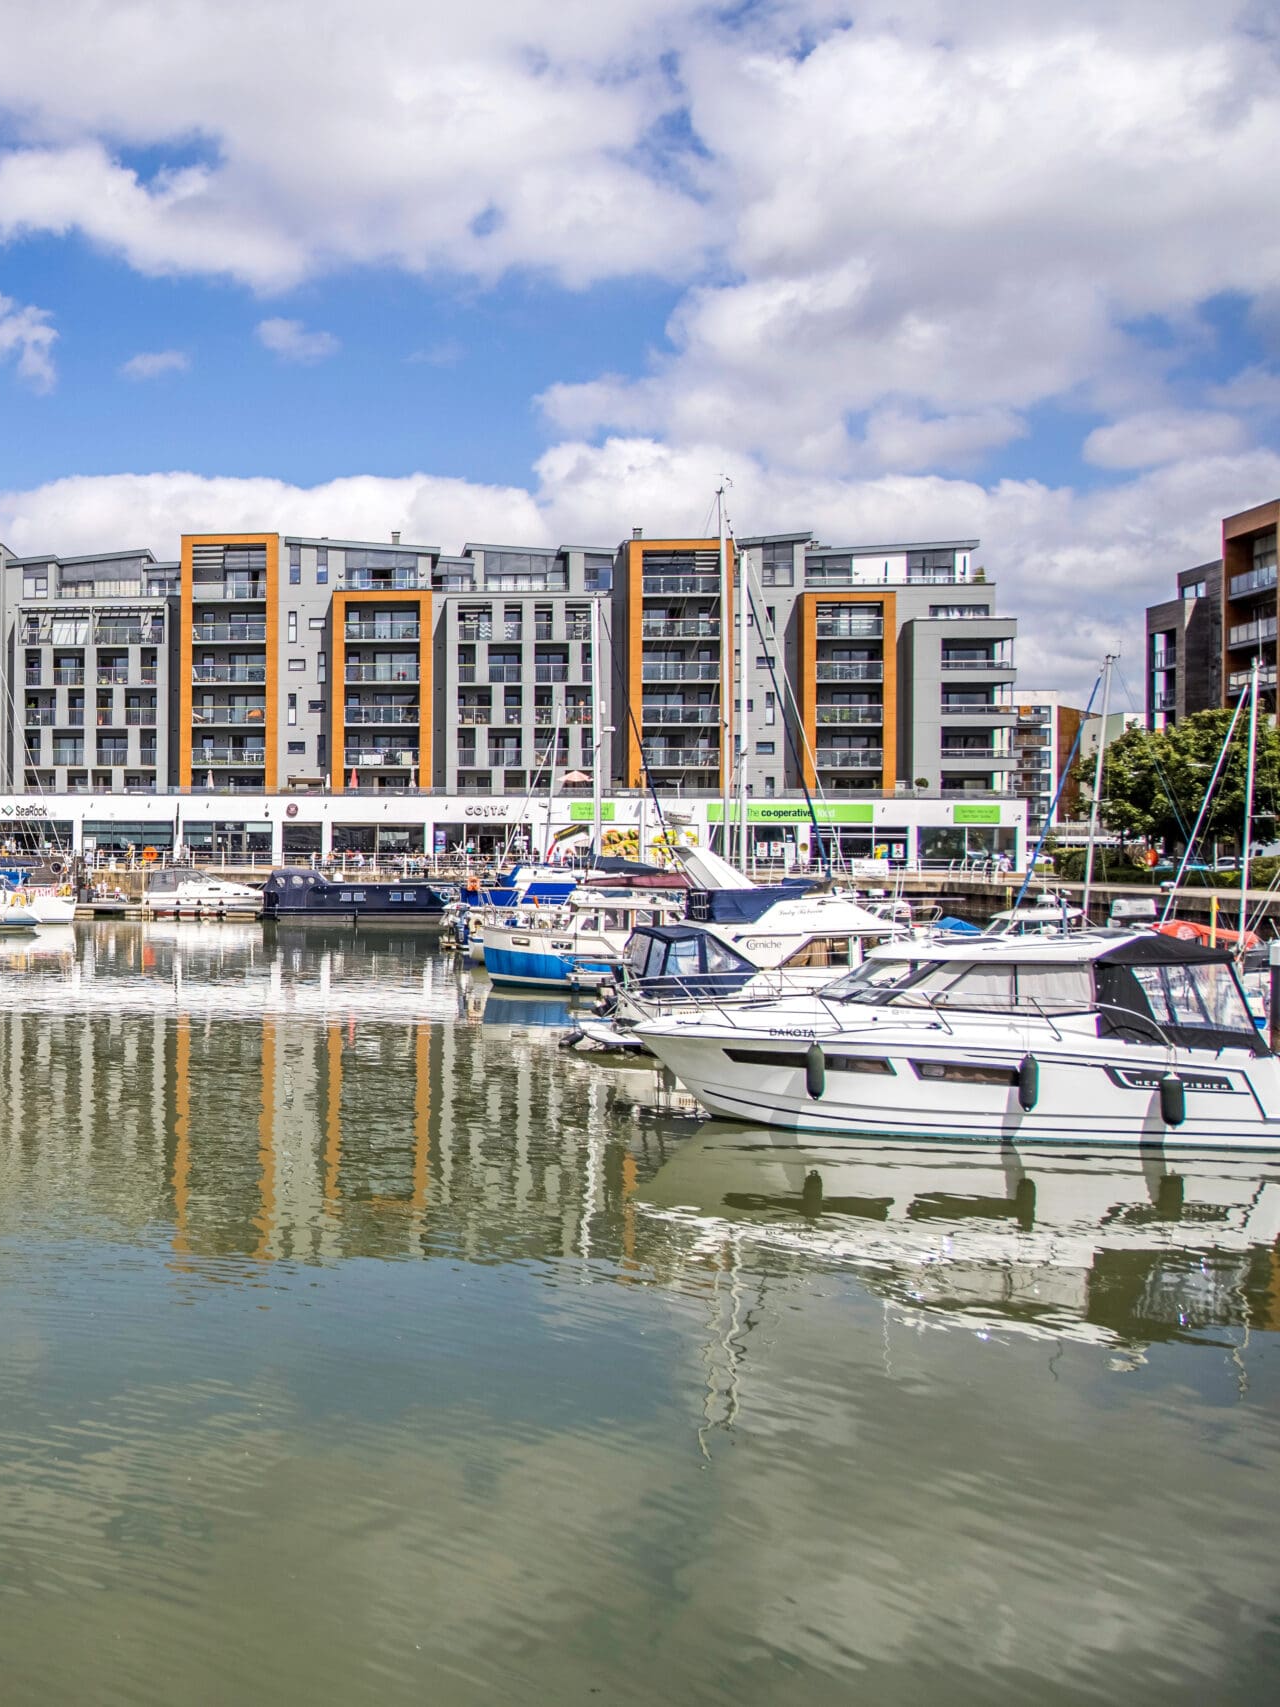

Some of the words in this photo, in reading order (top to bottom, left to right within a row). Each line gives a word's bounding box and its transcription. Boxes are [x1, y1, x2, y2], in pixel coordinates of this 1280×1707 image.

[15, 804, 47, 816] SeaRock
[465, 805, 507, 817] COSTA
[747, 808, 759, 817] The
[746, 939, 782, 951] Corniche
[769, 1028, 815, 1038] DAKOTA
[1182, 1081, 1228, 1090] FISHER
